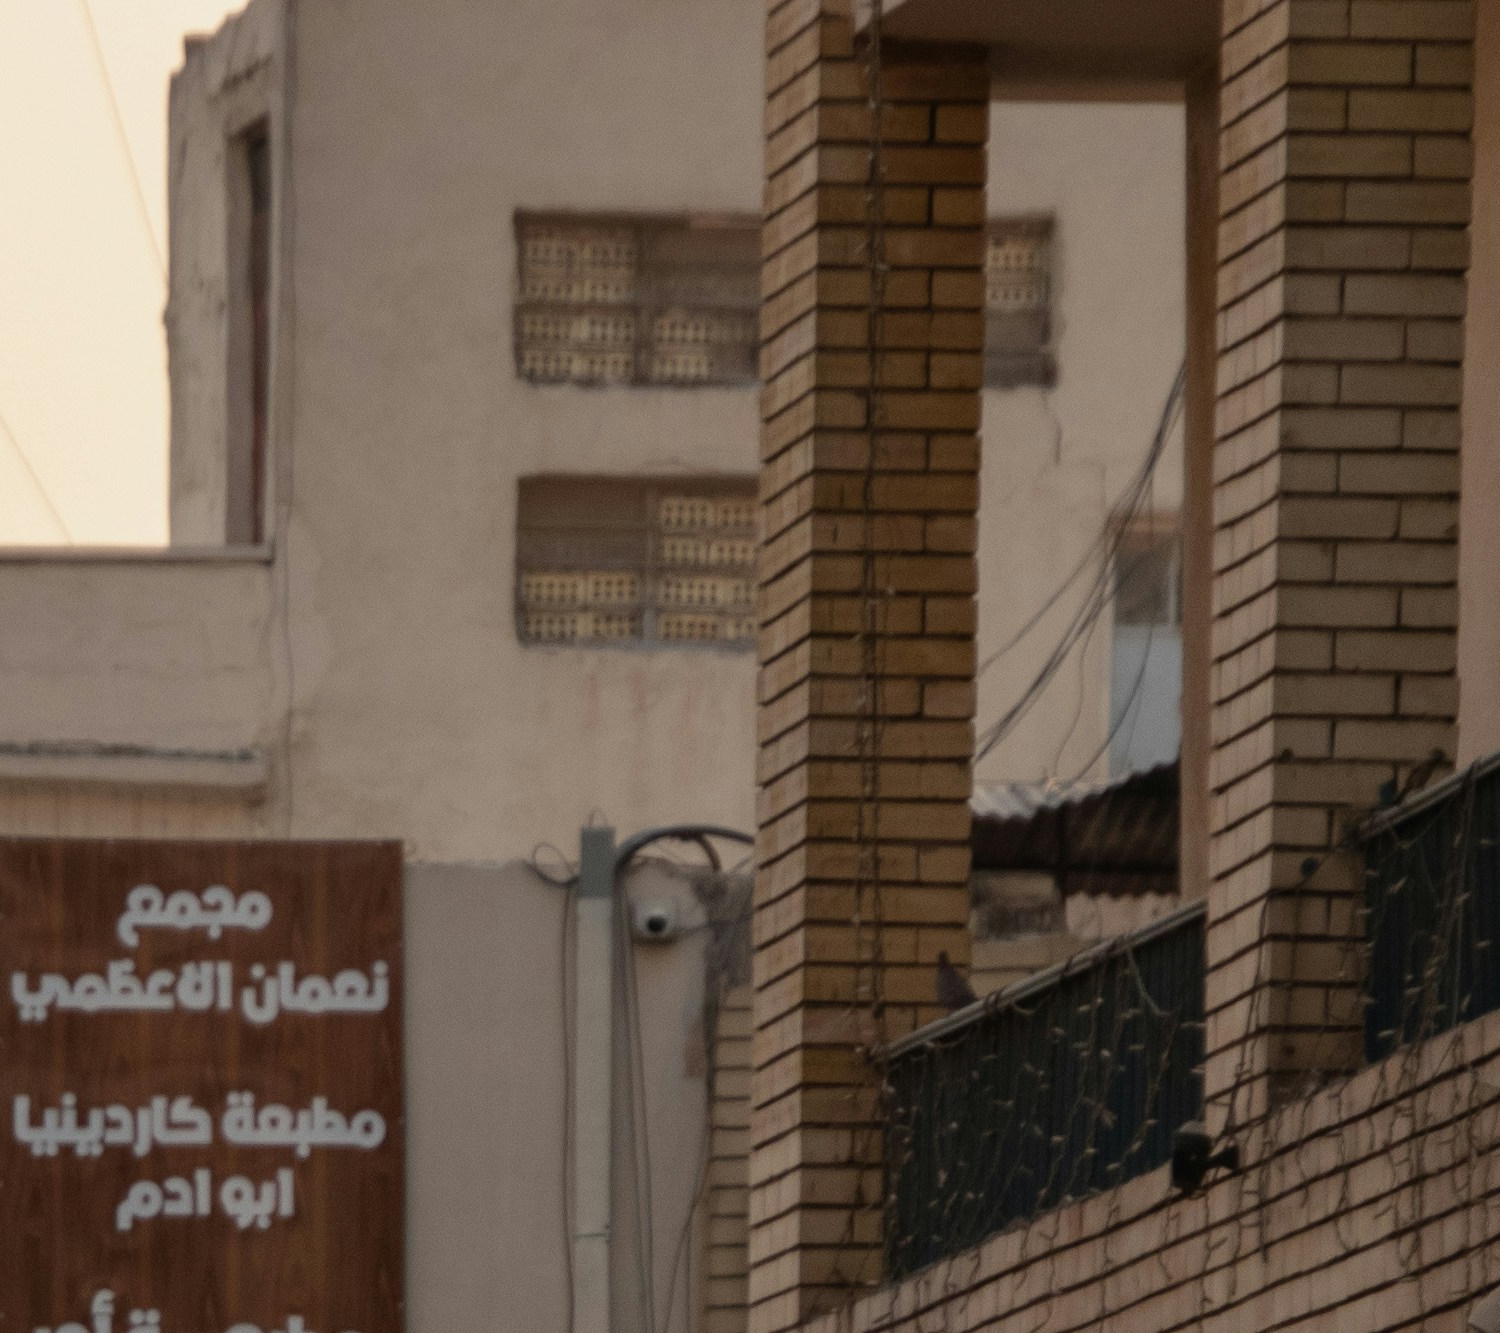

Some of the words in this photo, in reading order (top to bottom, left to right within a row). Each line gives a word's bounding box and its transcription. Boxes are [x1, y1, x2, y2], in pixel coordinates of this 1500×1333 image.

[116, 884, 273, 948] مجمع
[10, 958, 233, 1022] الاعظمي
[240, 961, 389, 1026] نعمان
[13, 1092, 213, 1157] كاردينيا
[221, 1091, 385, 1158] مطبعة
[116, 1168, 211, 1231] ادم
[219, 1168, 294, 1231] ابو
